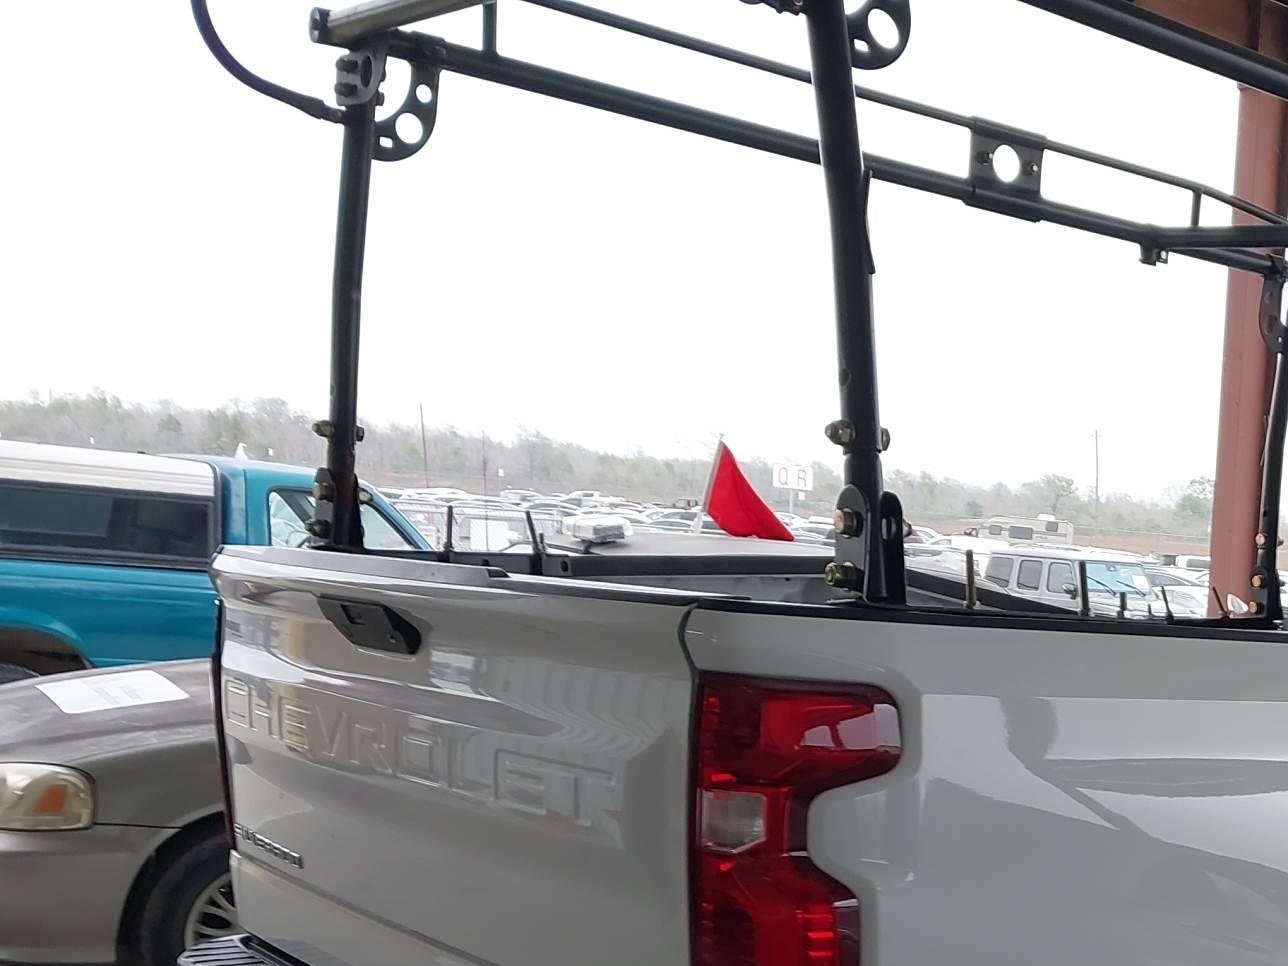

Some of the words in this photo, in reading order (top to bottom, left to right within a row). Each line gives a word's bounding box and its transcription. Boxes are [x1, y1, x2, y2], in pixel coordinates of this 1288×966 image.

[777, 466, 788, 486] Q
[797, 469, 807, 488] R
[224, 676, 617, 828] CHEVROLET
